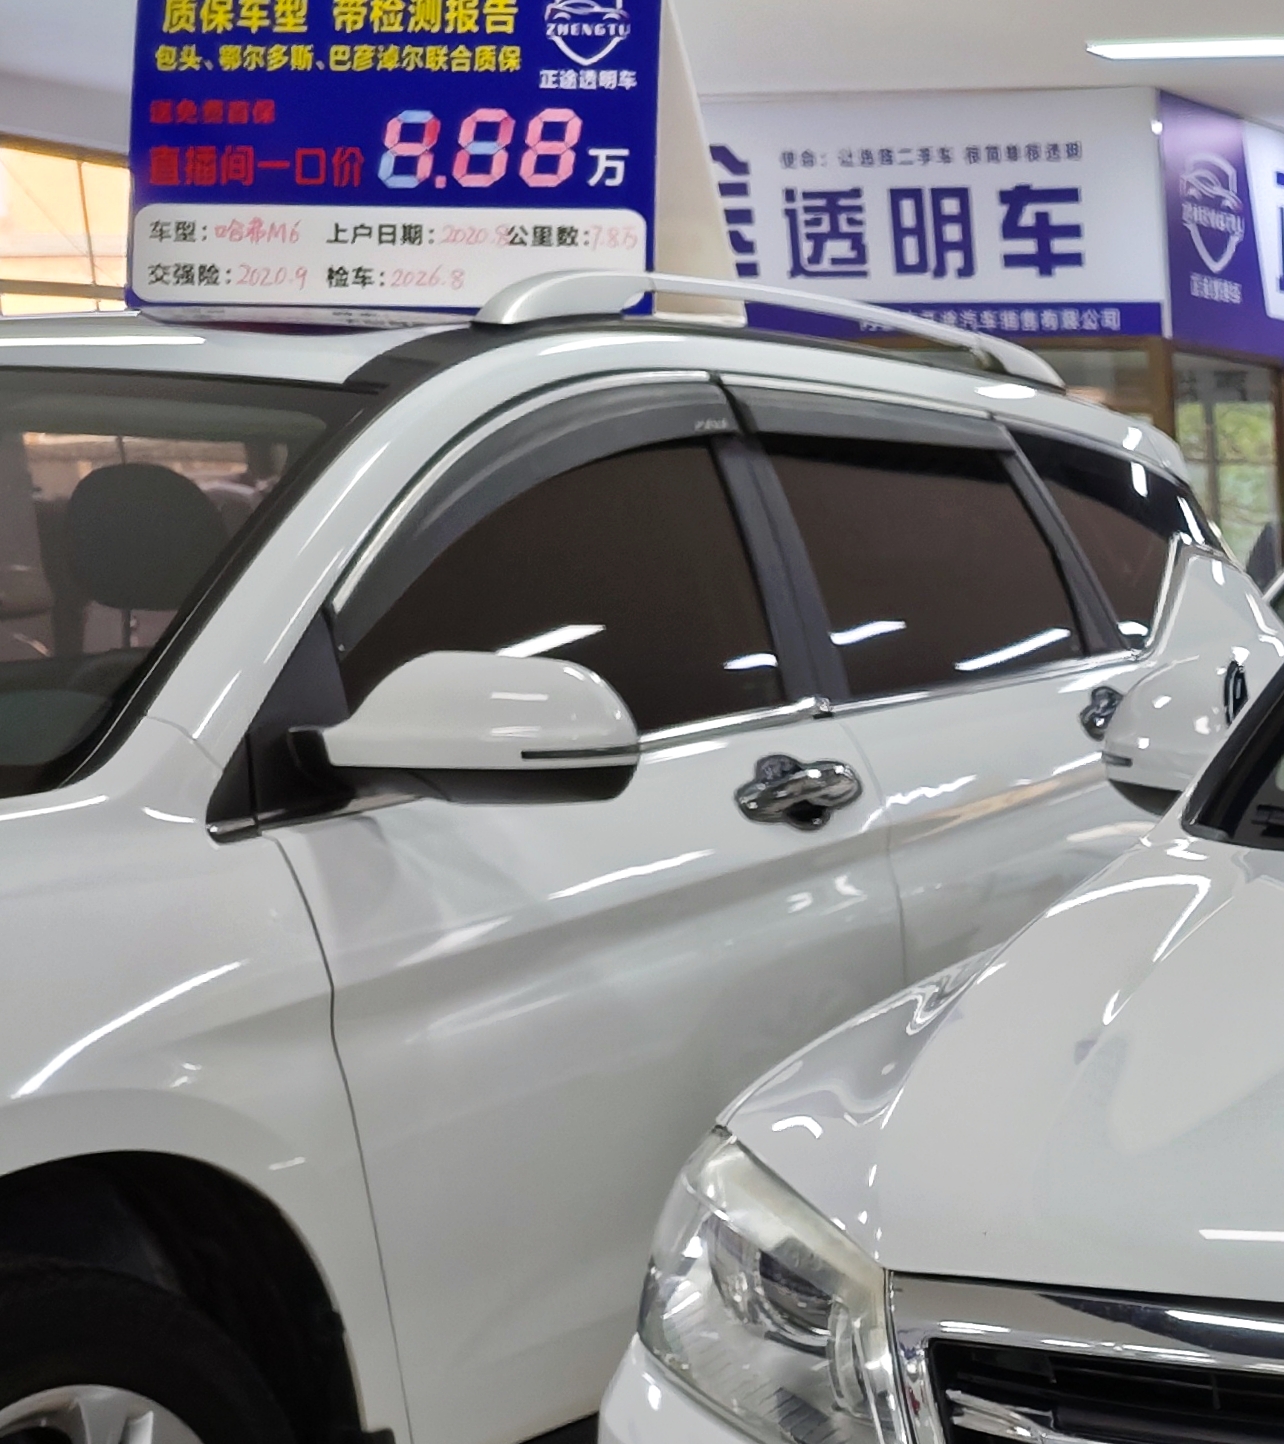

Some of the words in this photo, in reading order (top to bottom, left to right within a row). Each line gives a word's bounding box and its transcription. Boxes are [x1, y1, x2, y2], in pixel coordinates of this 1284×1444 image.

[162, 0, 309, 34] 质保车型
[332, 0, 519, 35] 带检测报告
[545, 22, 632, 37] ZHENGTU
[538, 69, 638, 90] 正途透明车
[149, 145, 365, 188] 直播间一口价
[587, 148, 630, 187] 万
